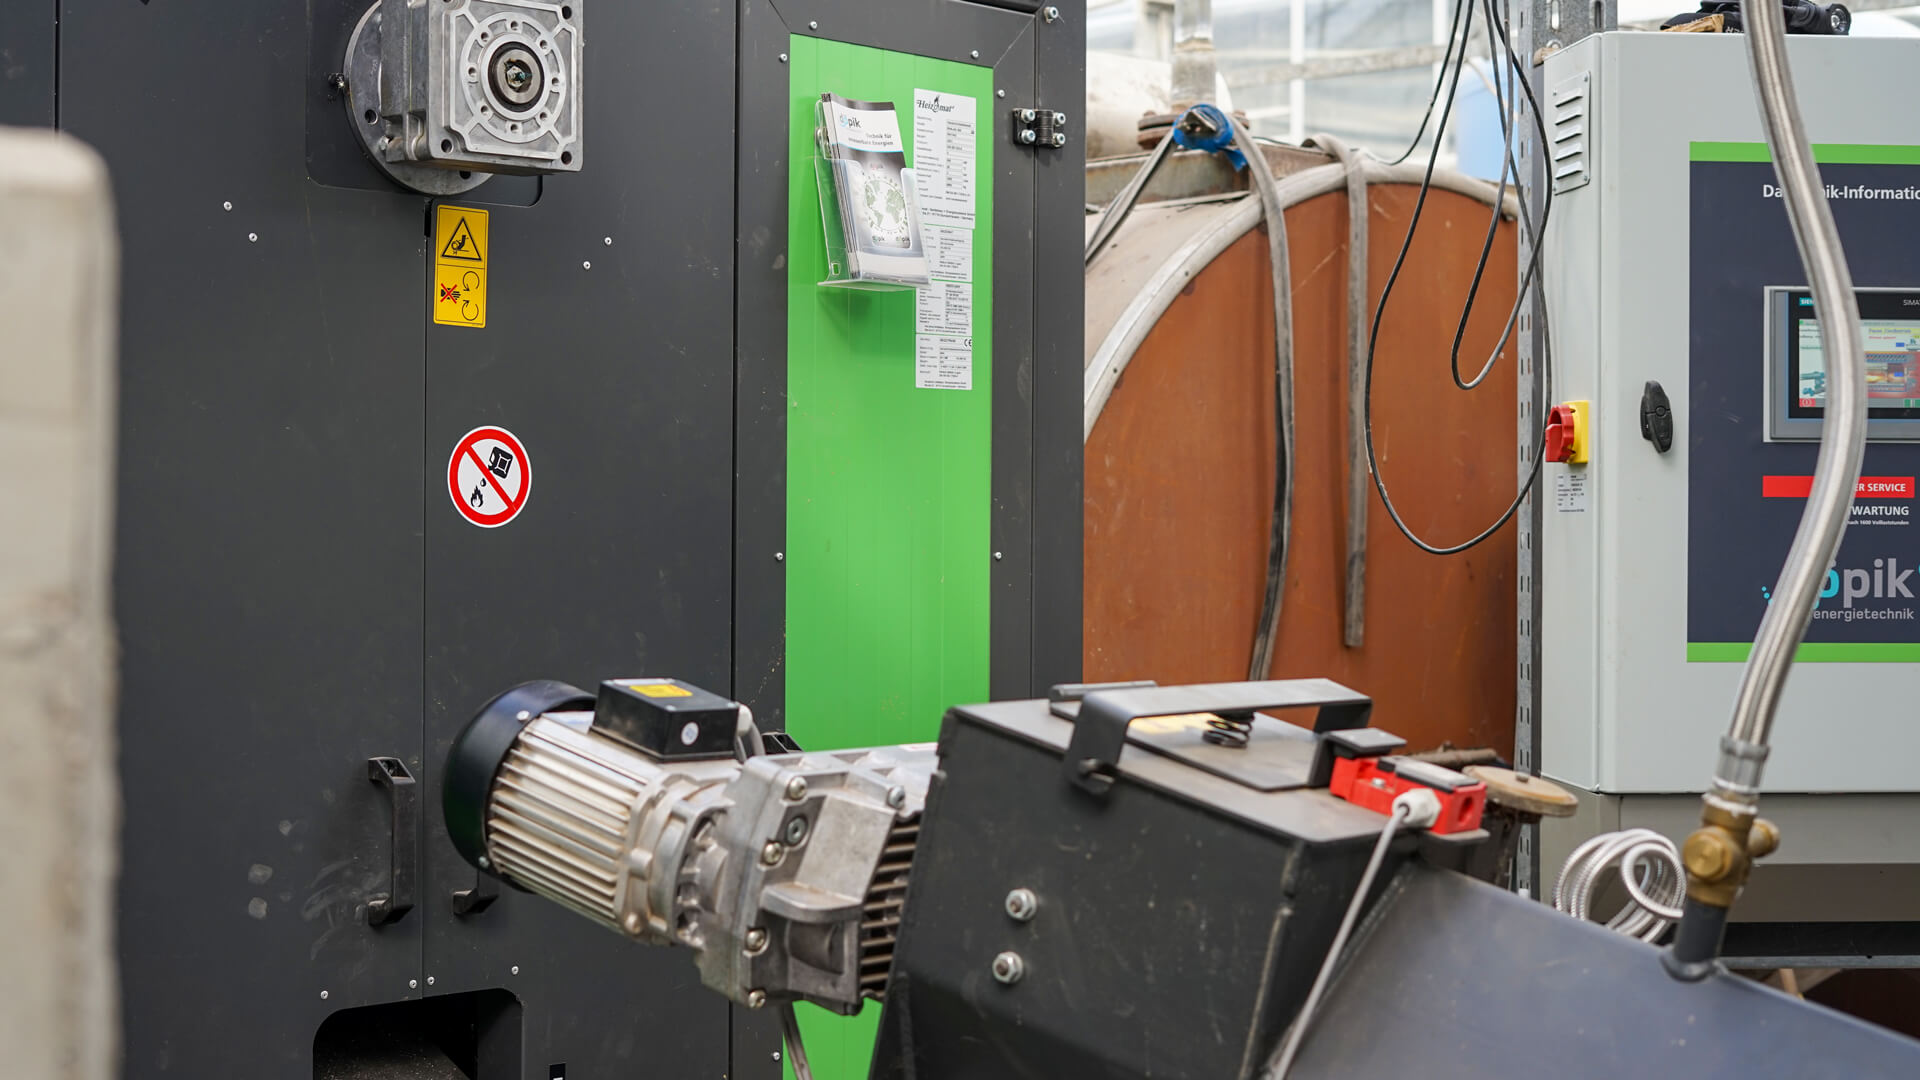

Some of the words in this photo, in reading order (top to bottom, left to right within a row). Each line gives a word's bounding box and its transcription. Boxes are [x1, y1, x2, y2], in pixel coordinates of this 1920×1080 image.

[1867, 483, 1906, 492] SERVICE
[1850, 505, 1910, 516] WARTUNG
[1813, 608, 1915, 622] energietechnik
